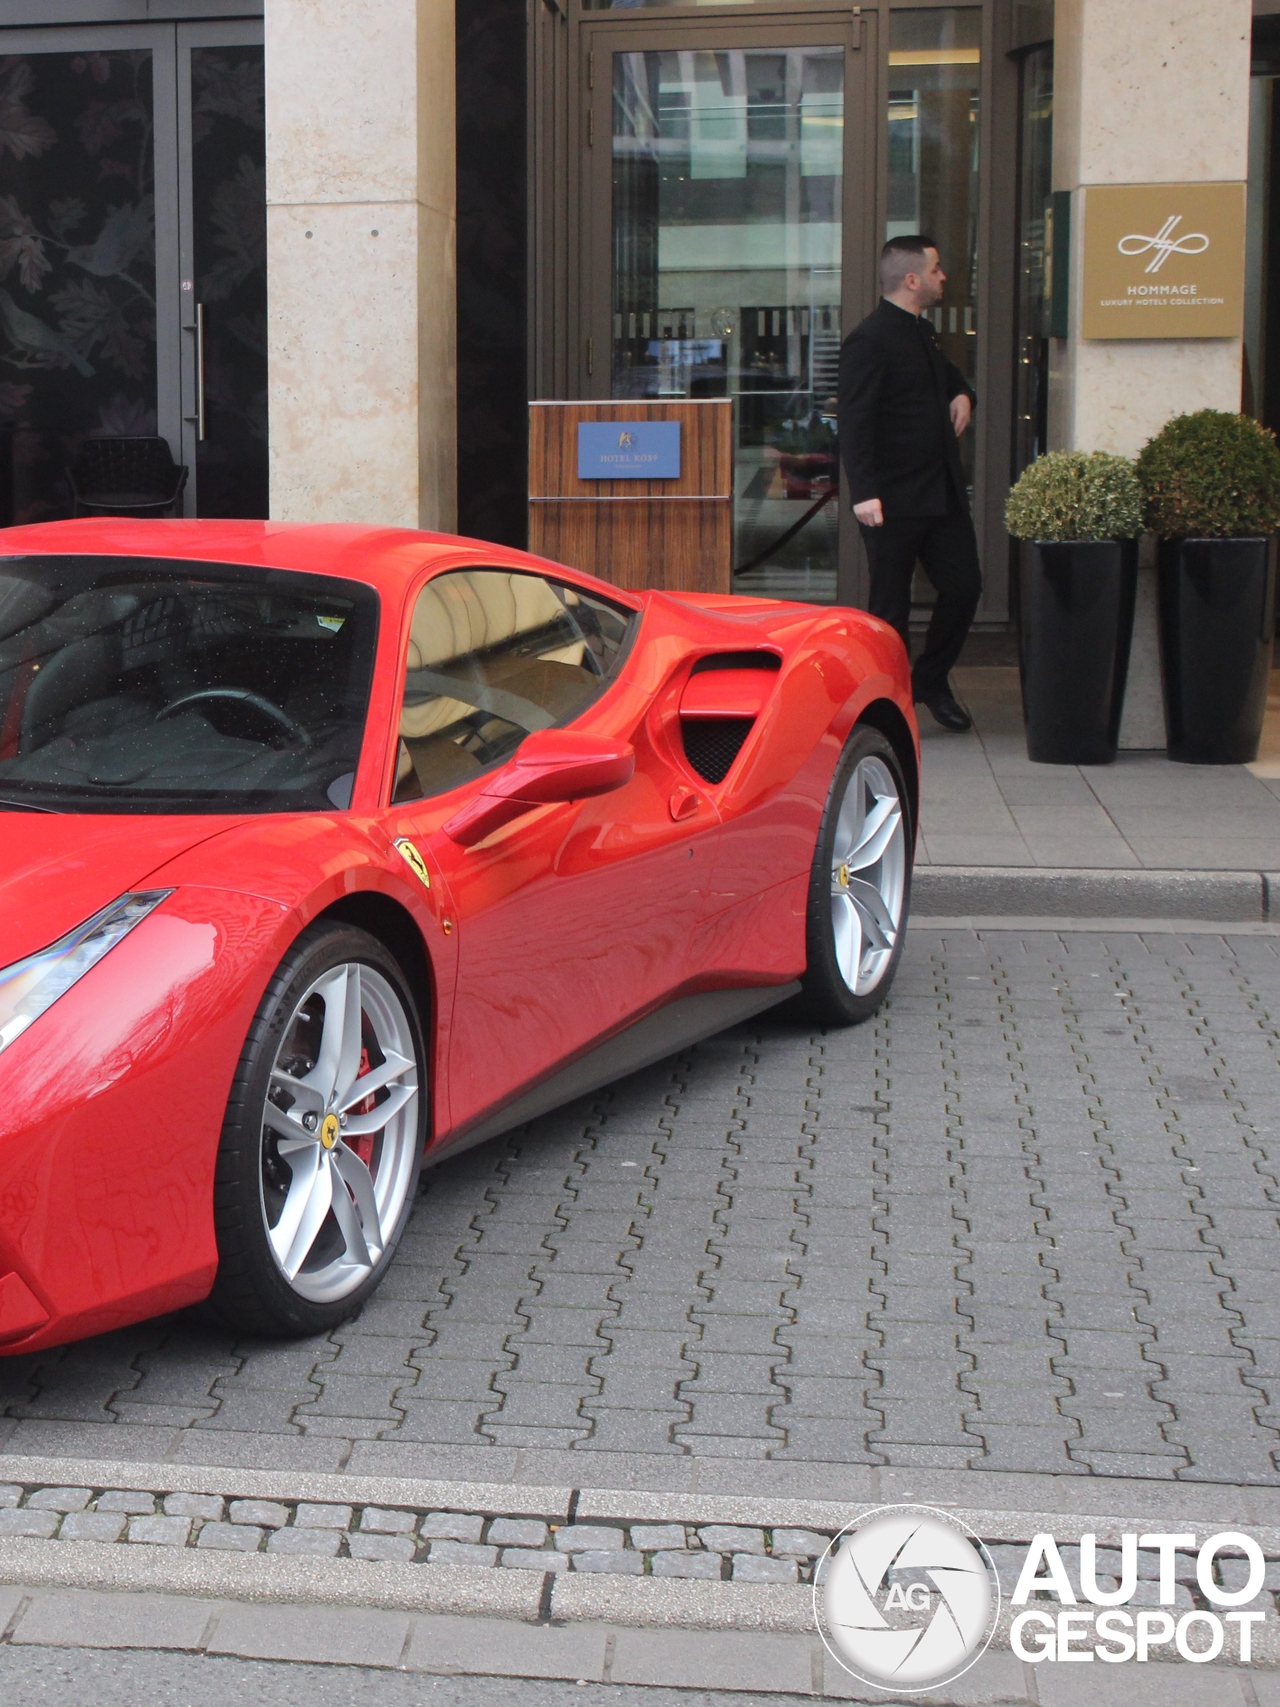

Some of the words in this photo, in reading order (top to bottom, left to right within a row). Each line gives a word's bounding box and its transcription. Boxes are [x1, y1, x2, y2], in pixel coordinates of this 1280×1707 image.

[1127, 285, 1197, 296] HOMMAGE
[1100, 299, 1132, 307] LUXURY
[1170, 297, 1224, 305] COLLECTION
[600, 454, 630, 463] HOTEL
